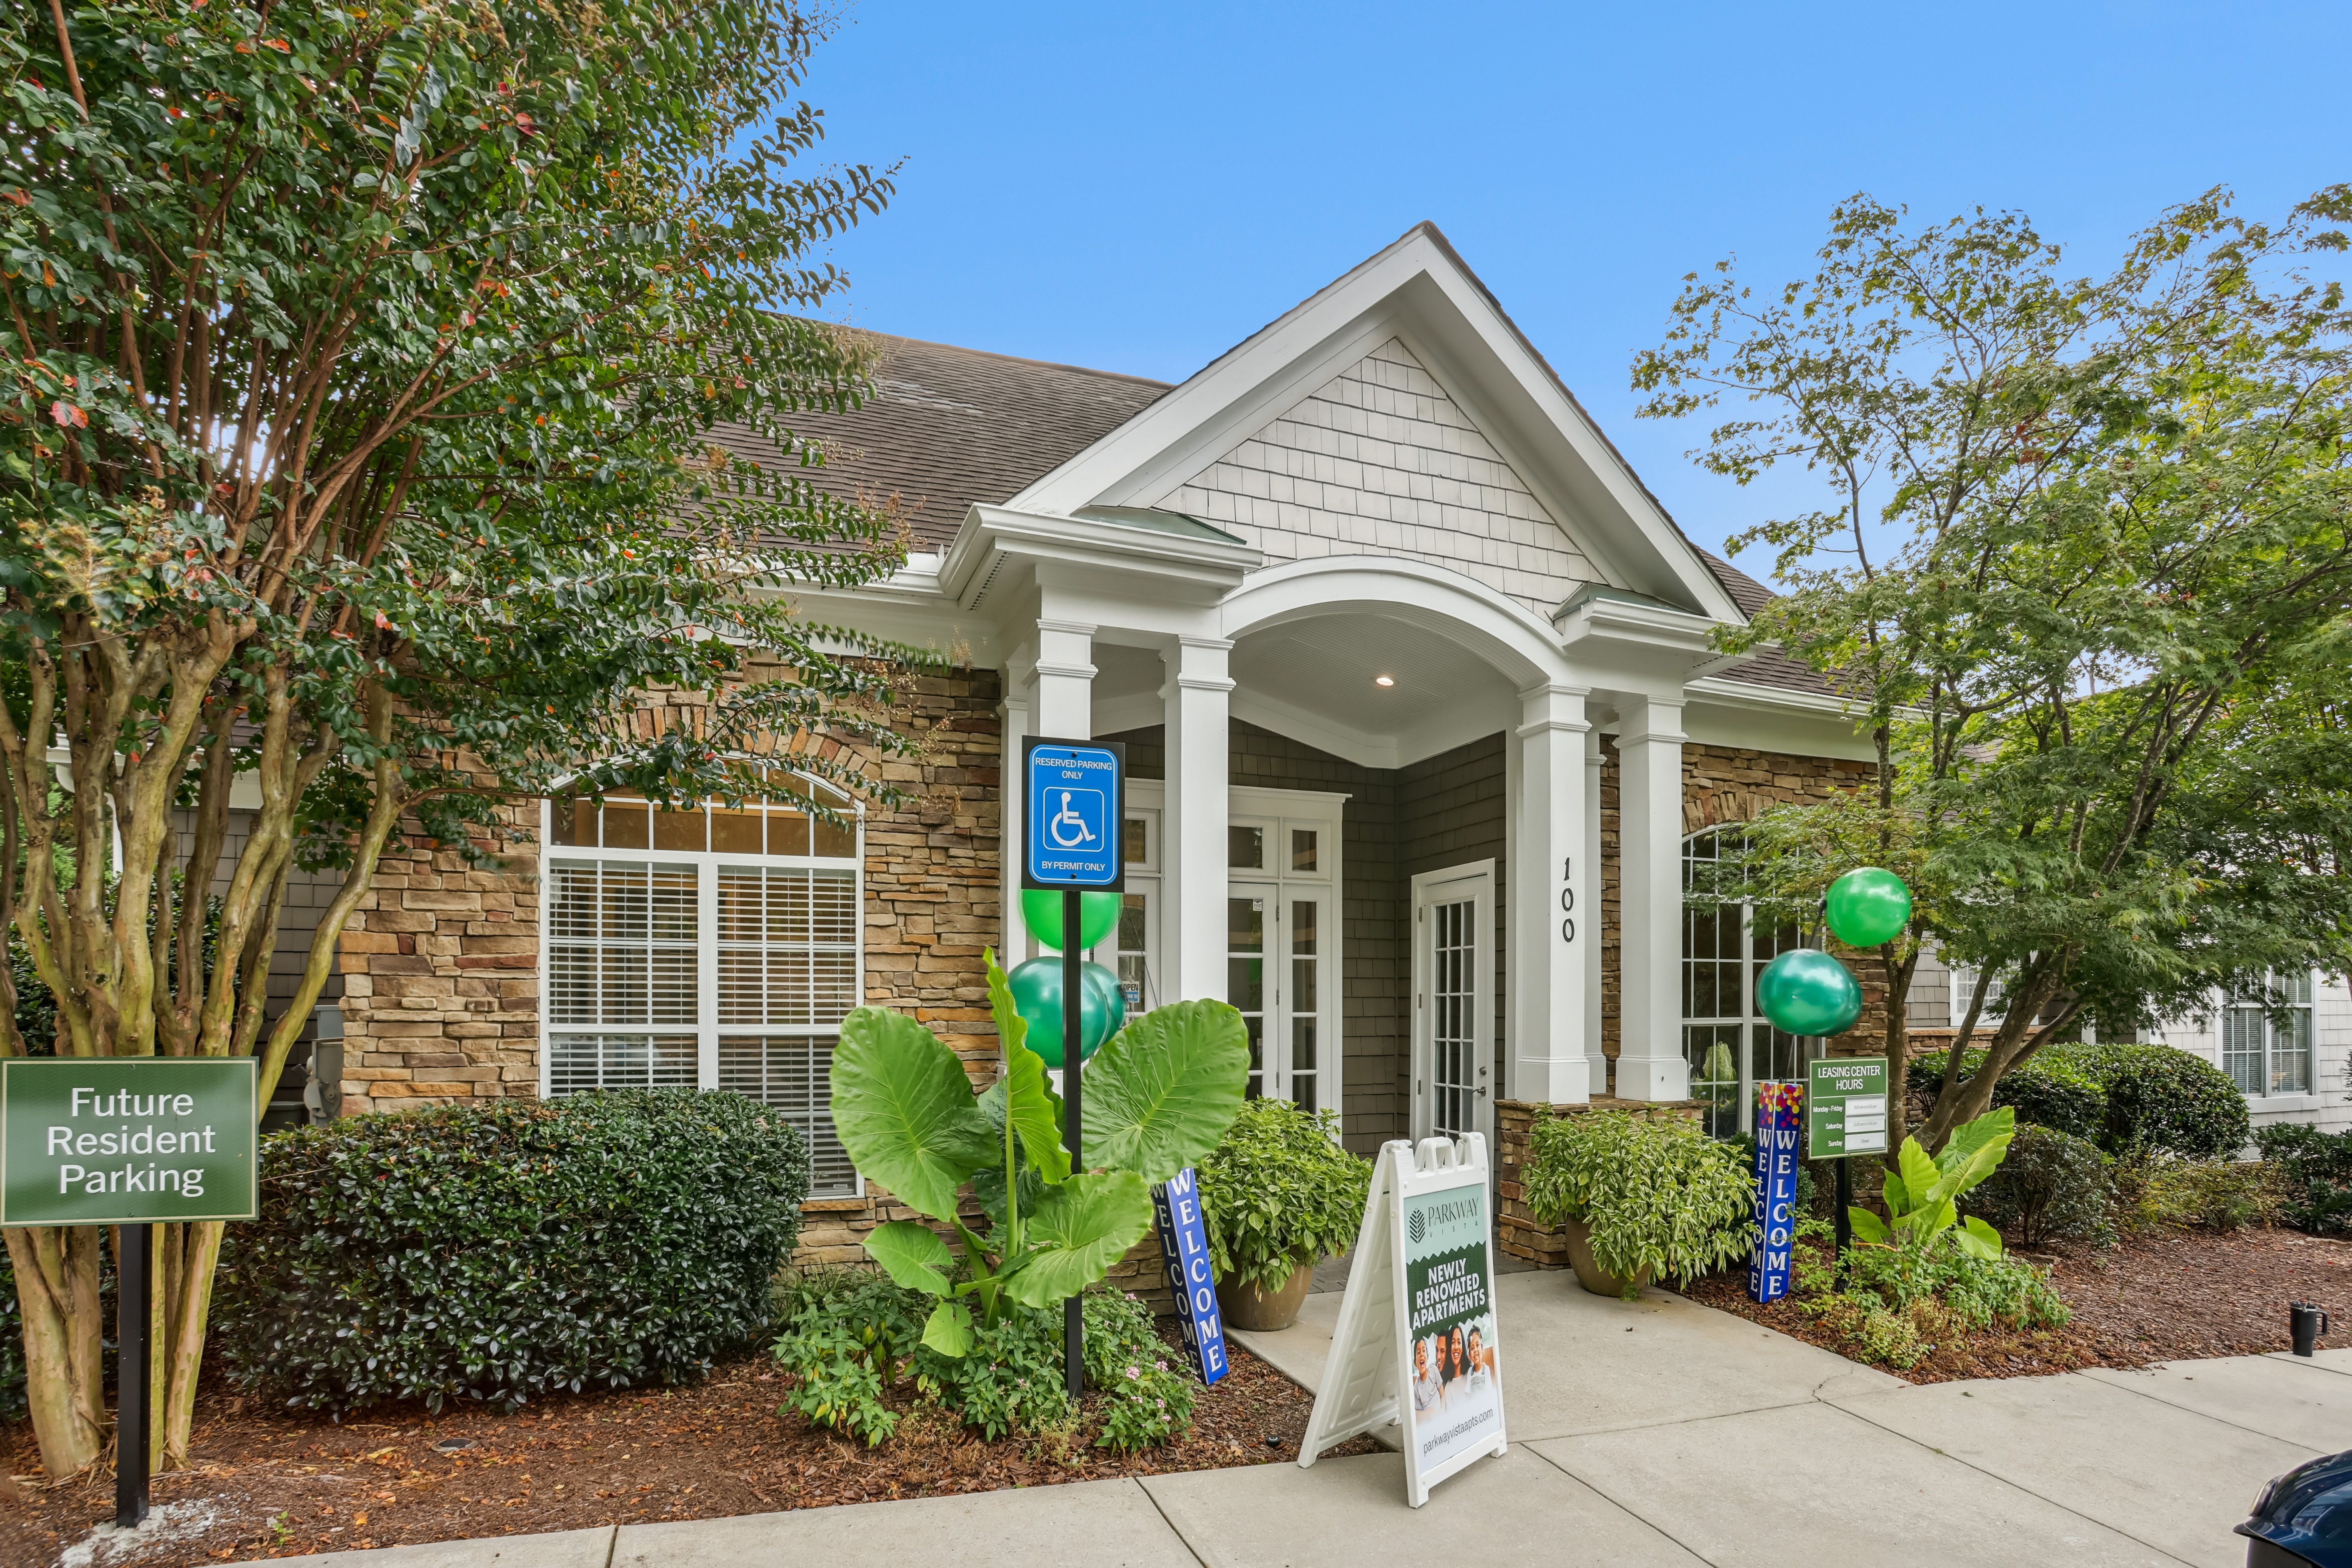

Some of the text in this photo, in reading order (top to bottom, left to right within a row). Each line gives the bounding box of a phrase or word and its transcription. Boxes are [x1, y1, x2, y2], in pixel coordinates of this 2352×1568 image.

[1035, 757, 1112, 770] RESERVED PARKING
[1062, 770, 1083, 779] ONLY
[1042, 861, 1105, 871] BY PERMIT ONLY
[1562, 857, 1574, 943] 100
[1818, 1065, 1880, 1078] LEASING CENTER
[1836, 1079, 1863, 1090] HOURS
[71, 1087, 194, 1117] Future
[47, 1125, 216, 1156] Resident
[60, 1163, 204, 1197] Parking
[1428, 1197, 1479, 1227] PARKWAY
[1750, 1127, 1771, 1292] WELCOME
[1767, 1130, 1797, 1295] WELCOME
[1429, 1221, 1479, 1238] VISTA
[1170, 1168, 1222, 1372] WELCOME
[1428, 1258, 1466, 1285] NEWLY
[1417, 1273, 1480, 1309] RENOVATED
[1412, 1289, 1485, 1331] APARTMENTS
[1423, 1407, 1493, 1457] parkwayvistaapts.com
